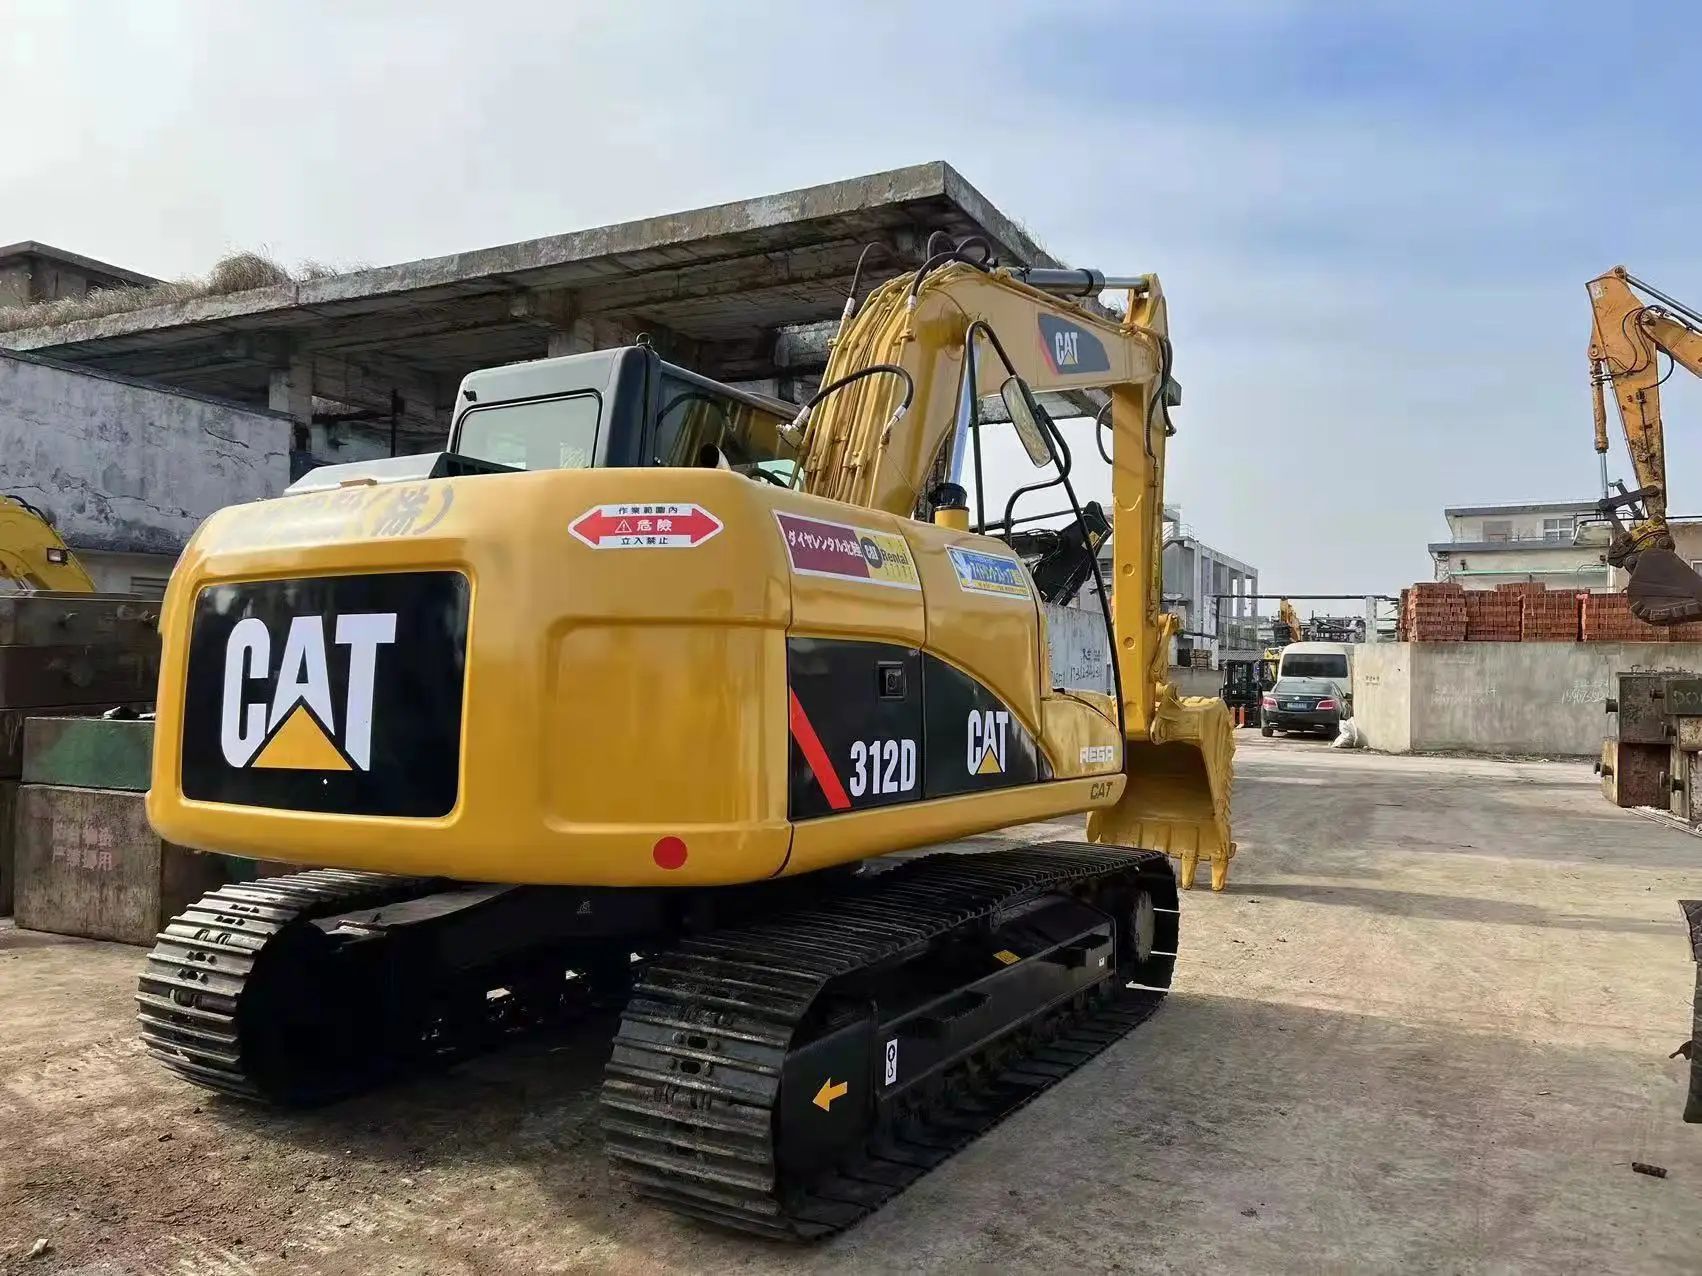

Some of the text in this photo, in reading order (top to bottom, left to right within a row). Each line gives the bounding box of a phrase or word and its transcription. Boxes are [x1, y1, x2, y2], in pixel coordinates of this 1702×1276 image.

[1055, 331, 1078, 366] CAT
[620, 537, 669, 545] 立入禁止
[788, 529, 864, 558] ダイヤレンタル北陸
[880, 548, 909, 566] Rental
[221, 612, 398, 772] CAT
[967, 709, 1009, 776] CAT
[849, 738, 917, 797] 312D
[1090, 781, 1114, 800] CAT
